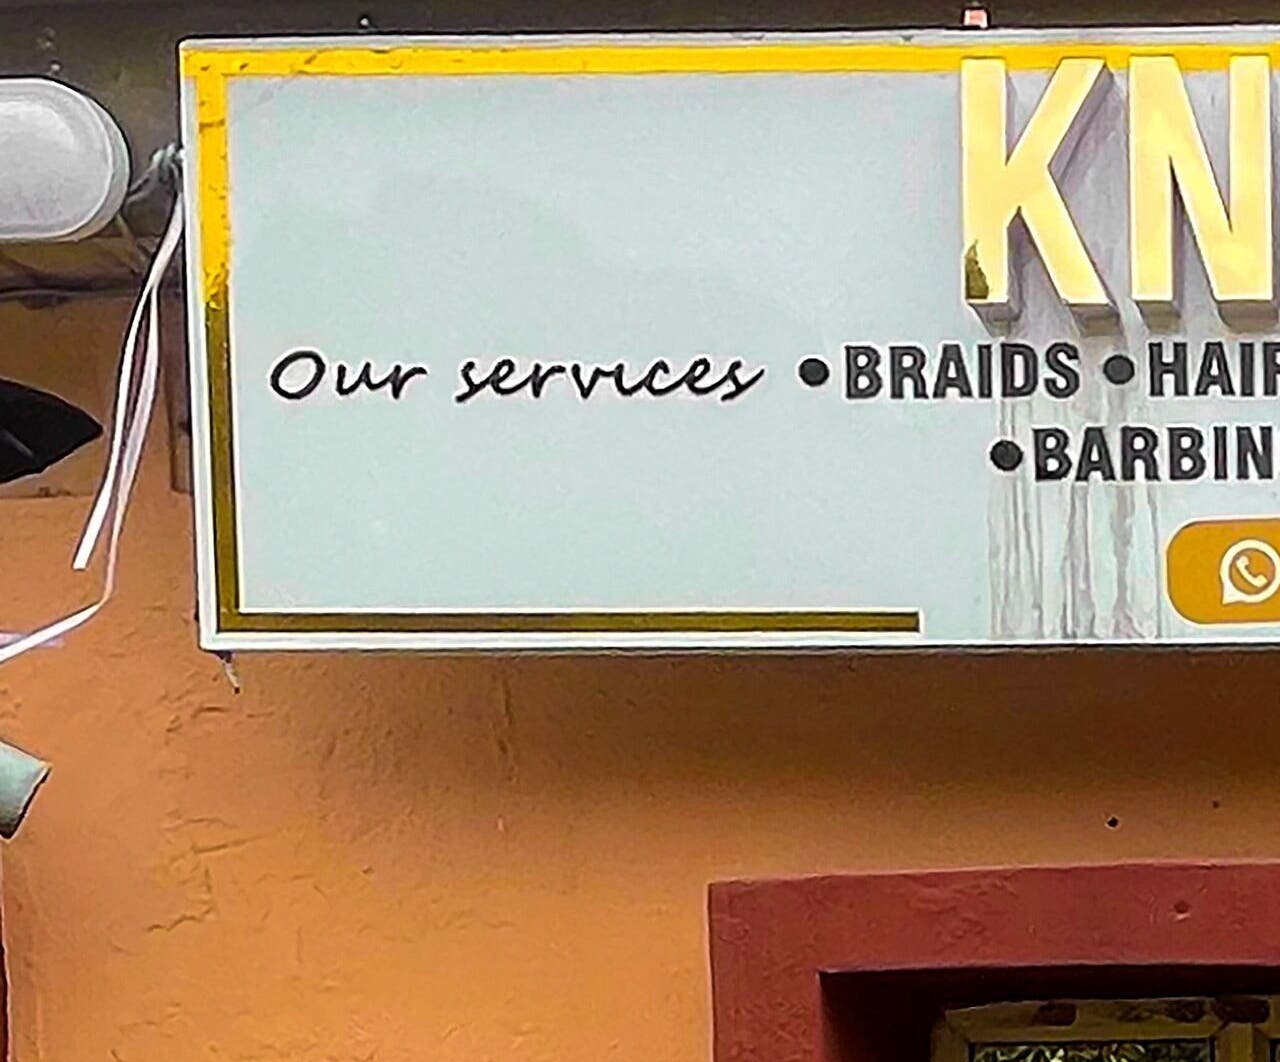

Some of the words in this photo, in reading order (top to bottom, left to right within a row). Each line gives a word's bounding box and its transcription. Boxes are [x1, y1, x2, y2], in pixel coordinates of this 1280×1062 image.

[269, 349, 428, 402] Our
[453, 351, 765, 404] services
[843, 341, 1081, 399] BRAIDS
